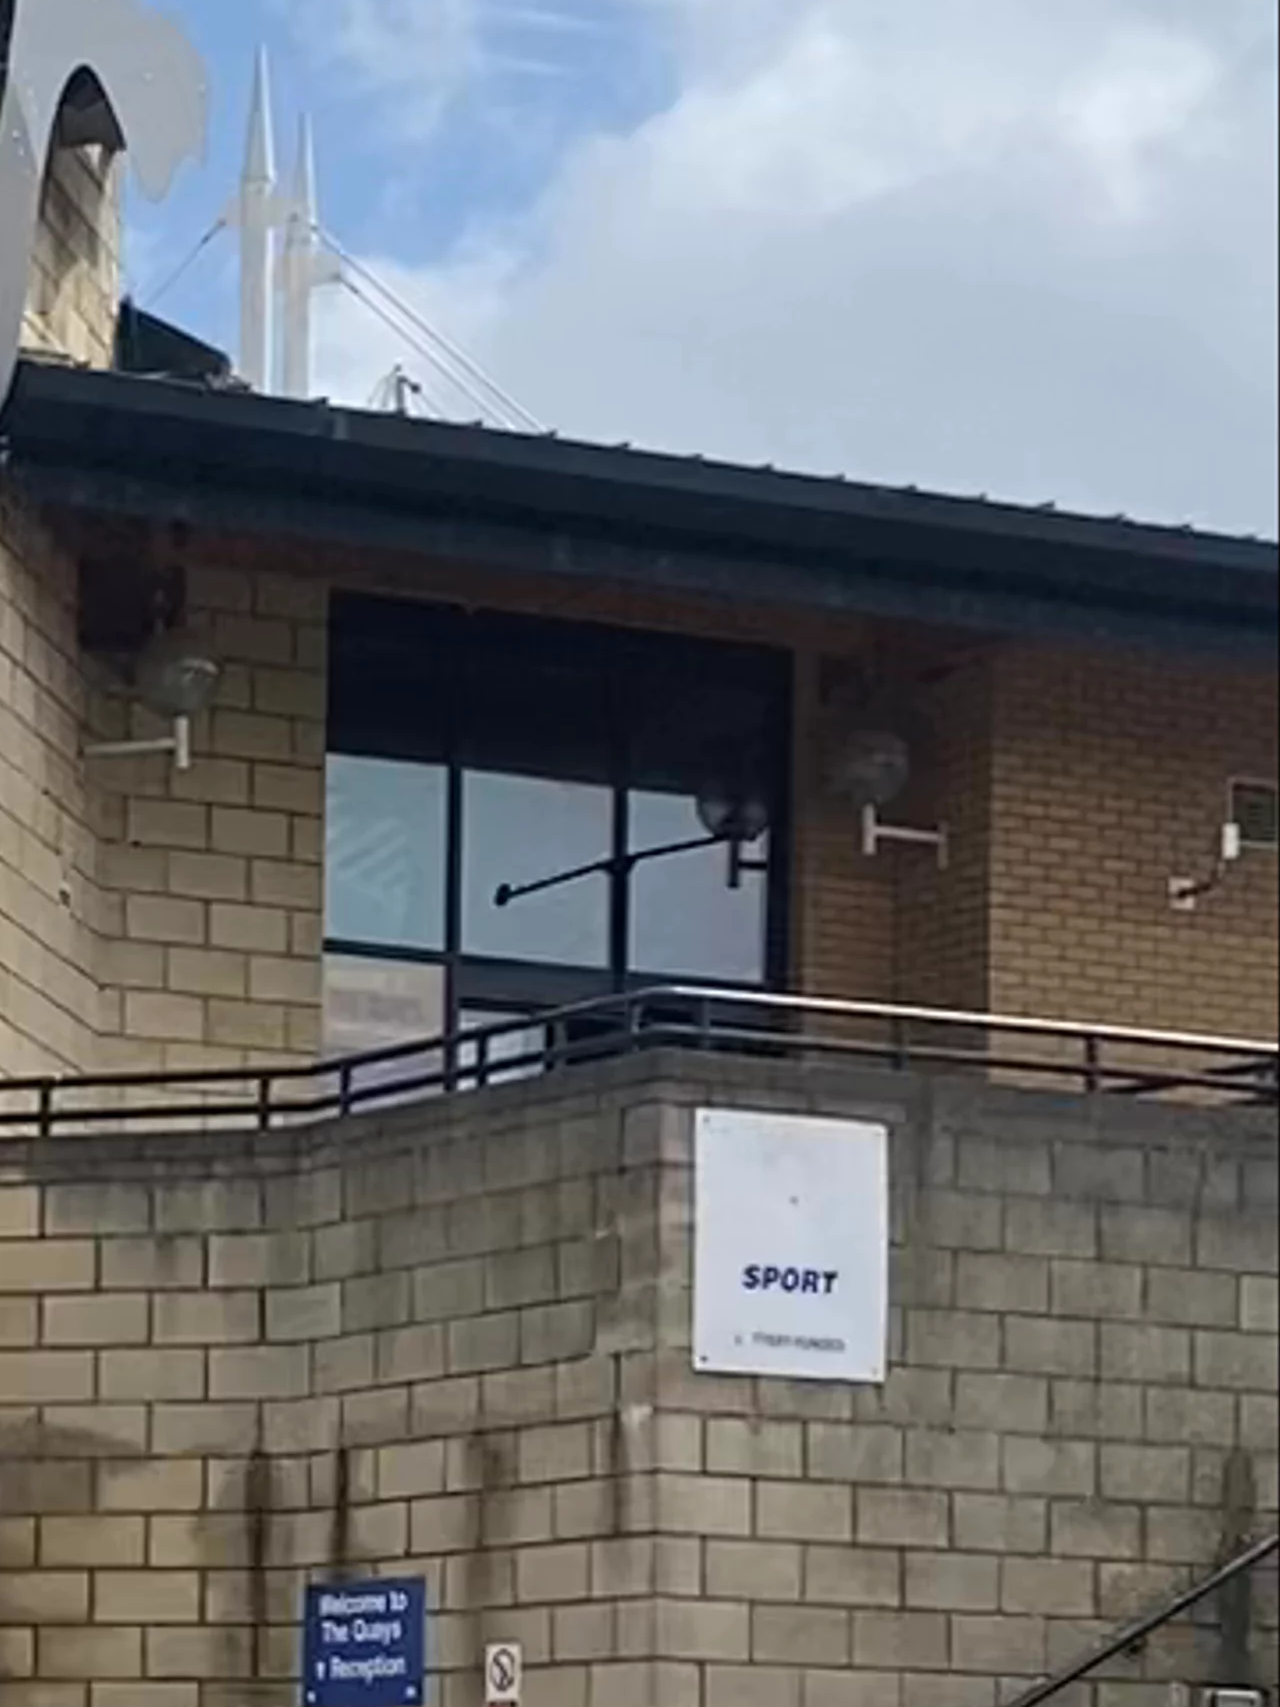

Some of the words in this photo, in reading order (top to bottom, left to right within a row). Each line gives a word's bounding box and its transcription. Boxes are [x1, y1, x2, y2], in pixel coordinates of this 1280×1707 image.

[741, 1263, 839, 1294] SPORT
[319, 1592, 387, 1616] Welcome
[388, 1590, 408, 1612] to
[321, 1619, 349, 1643] The
[352, 1618, 402, 1647] Quays
[329, 1654, 406, 1685] Reception
